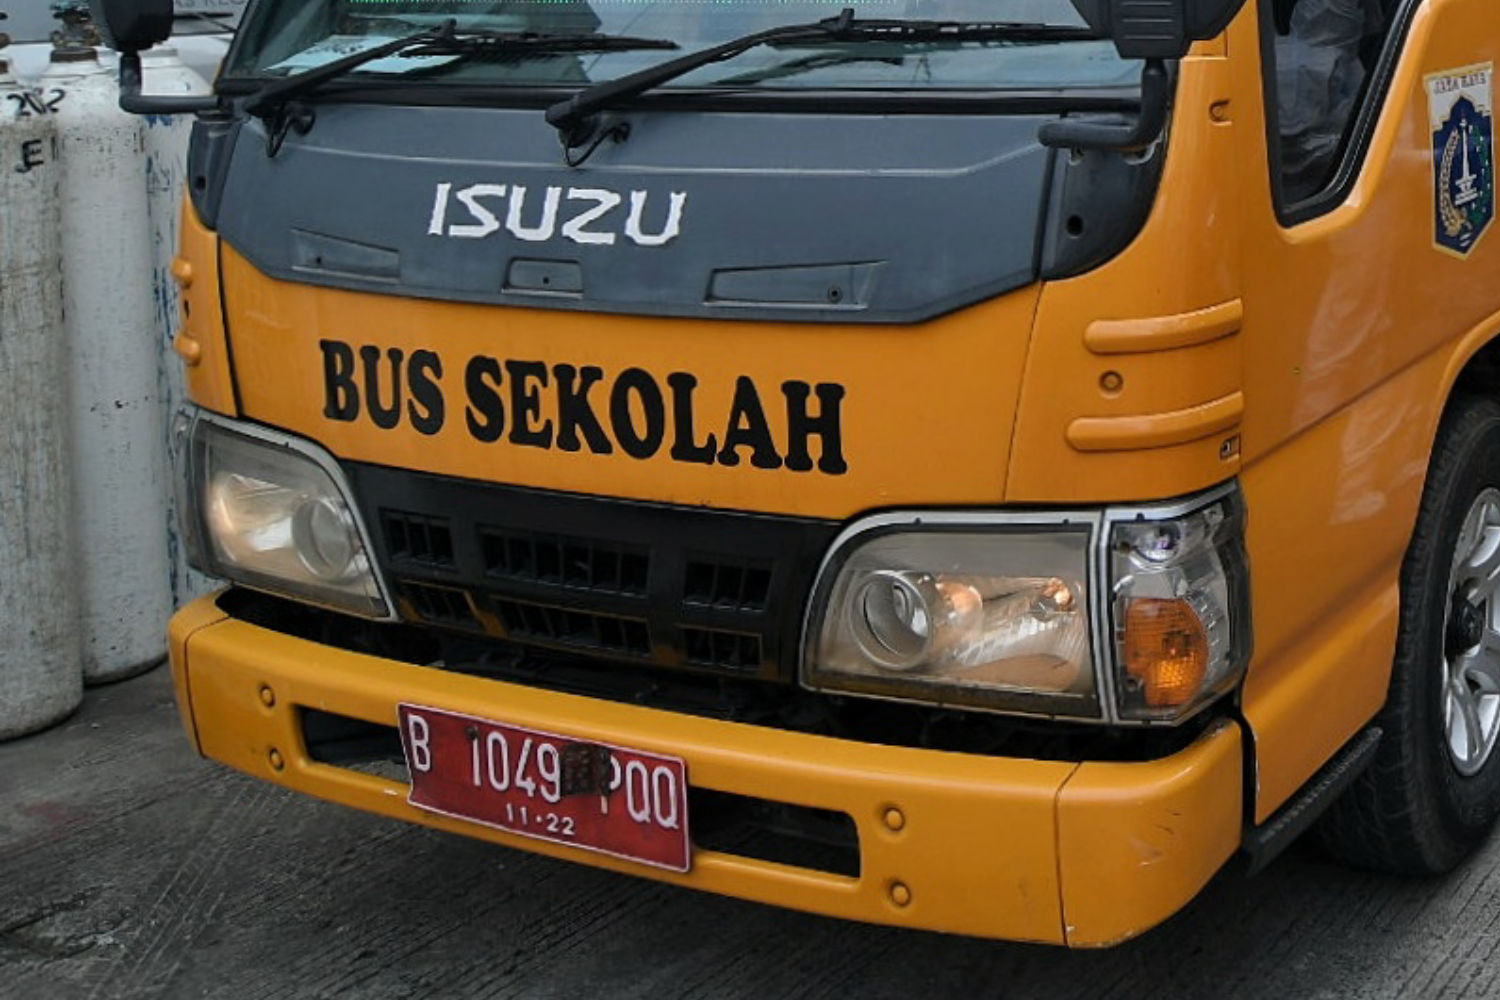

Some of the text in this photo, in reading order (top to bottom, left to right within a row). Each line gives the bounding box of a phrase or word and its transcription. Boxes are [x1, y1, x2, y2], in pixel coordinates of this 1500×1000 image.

[427, 182, 687, 246] ISUZU
[319, 338, 848, 475] BUS SEKOLAH
[407, 714, 432, 772] B
[469, 729, 561, 804] 1049
